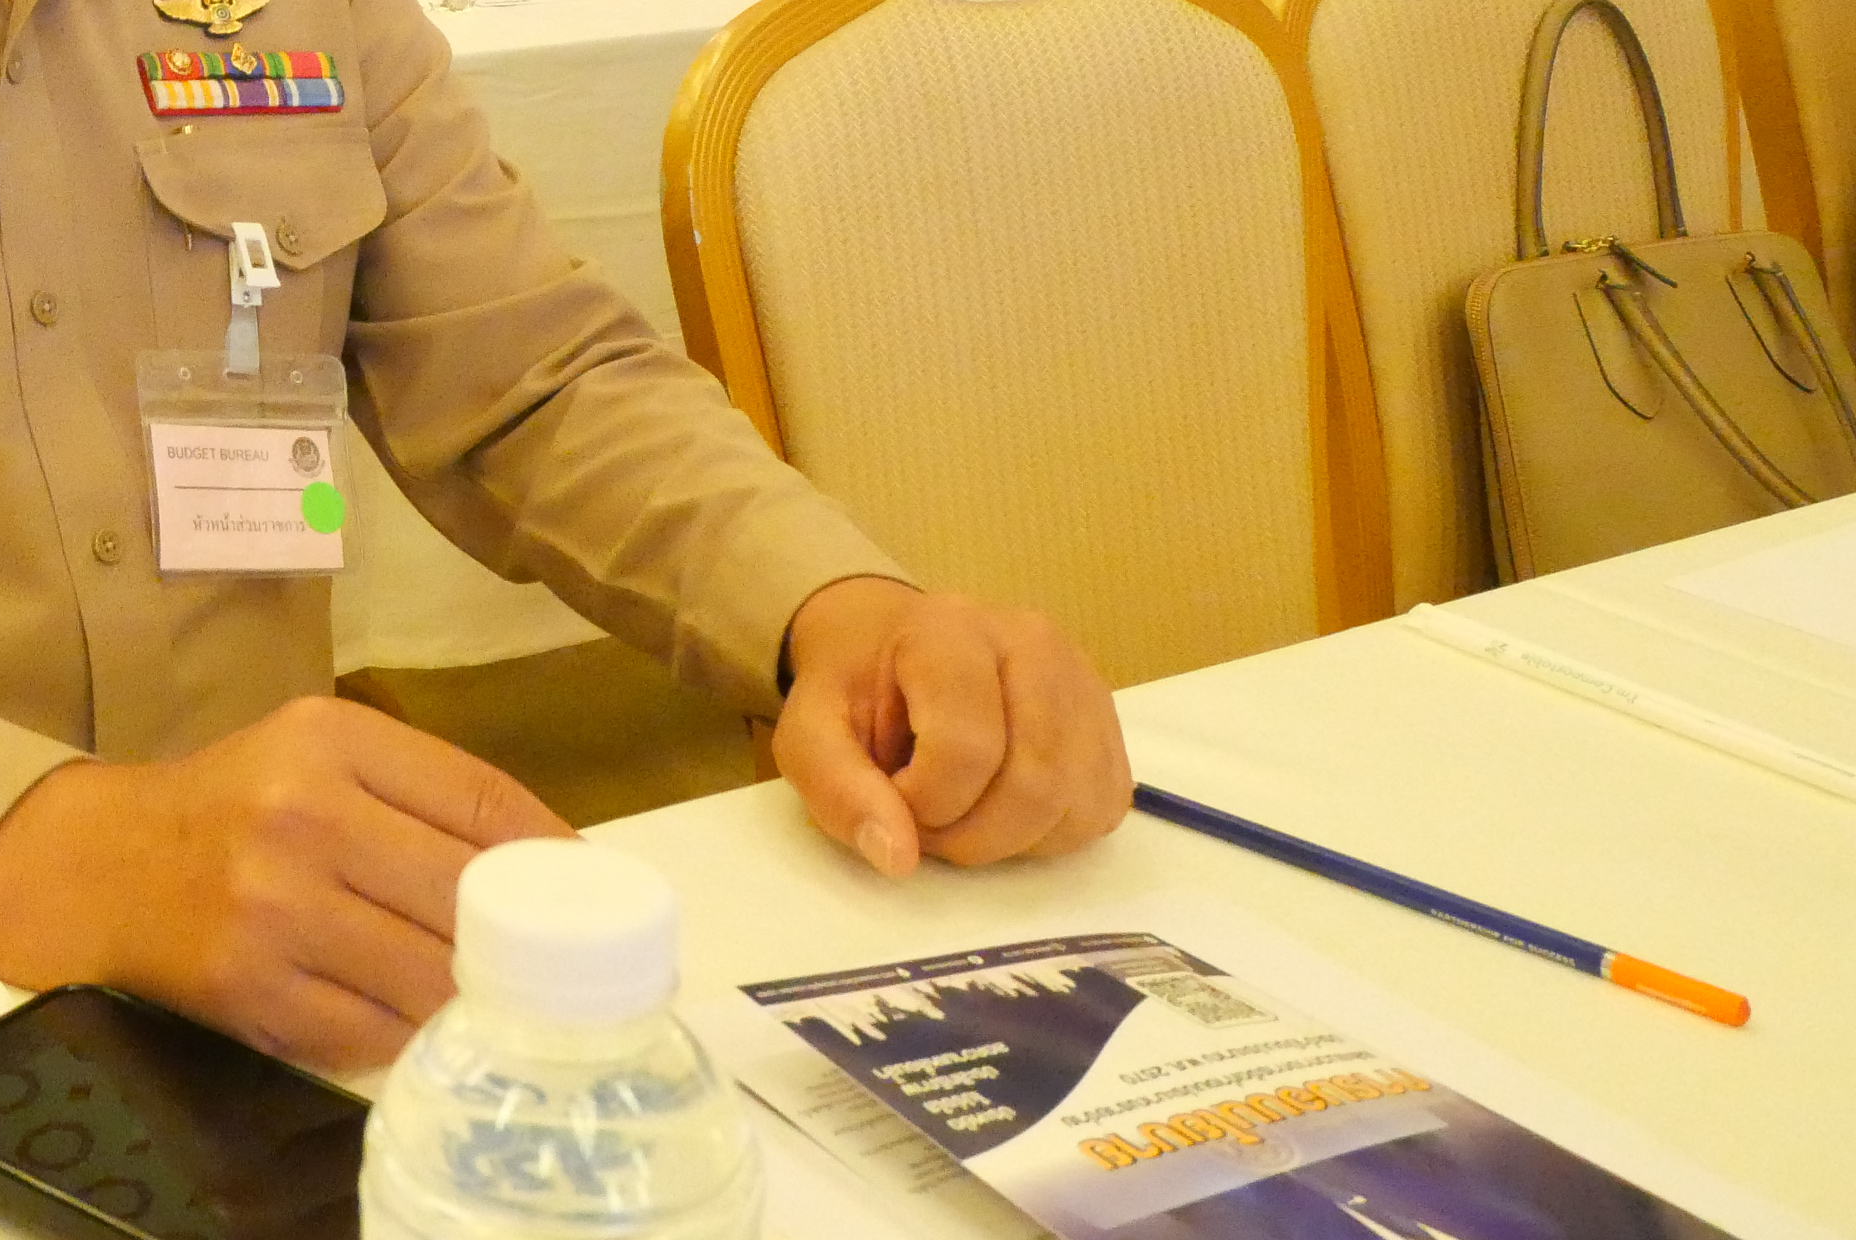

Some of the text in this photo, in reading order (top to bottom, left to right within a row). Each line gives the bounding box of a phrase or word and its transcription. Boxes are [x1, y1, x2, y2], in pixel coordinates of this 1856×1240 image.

[167, 446, 269, 462] BUDGET BUREAU
[193, 512, 305, 533] หัวหน้าส่วนราชการ
[1521, 653, 1613, 694] Compostable
[1078, 1067, 1434, 1171] การมอบนโยบาย
